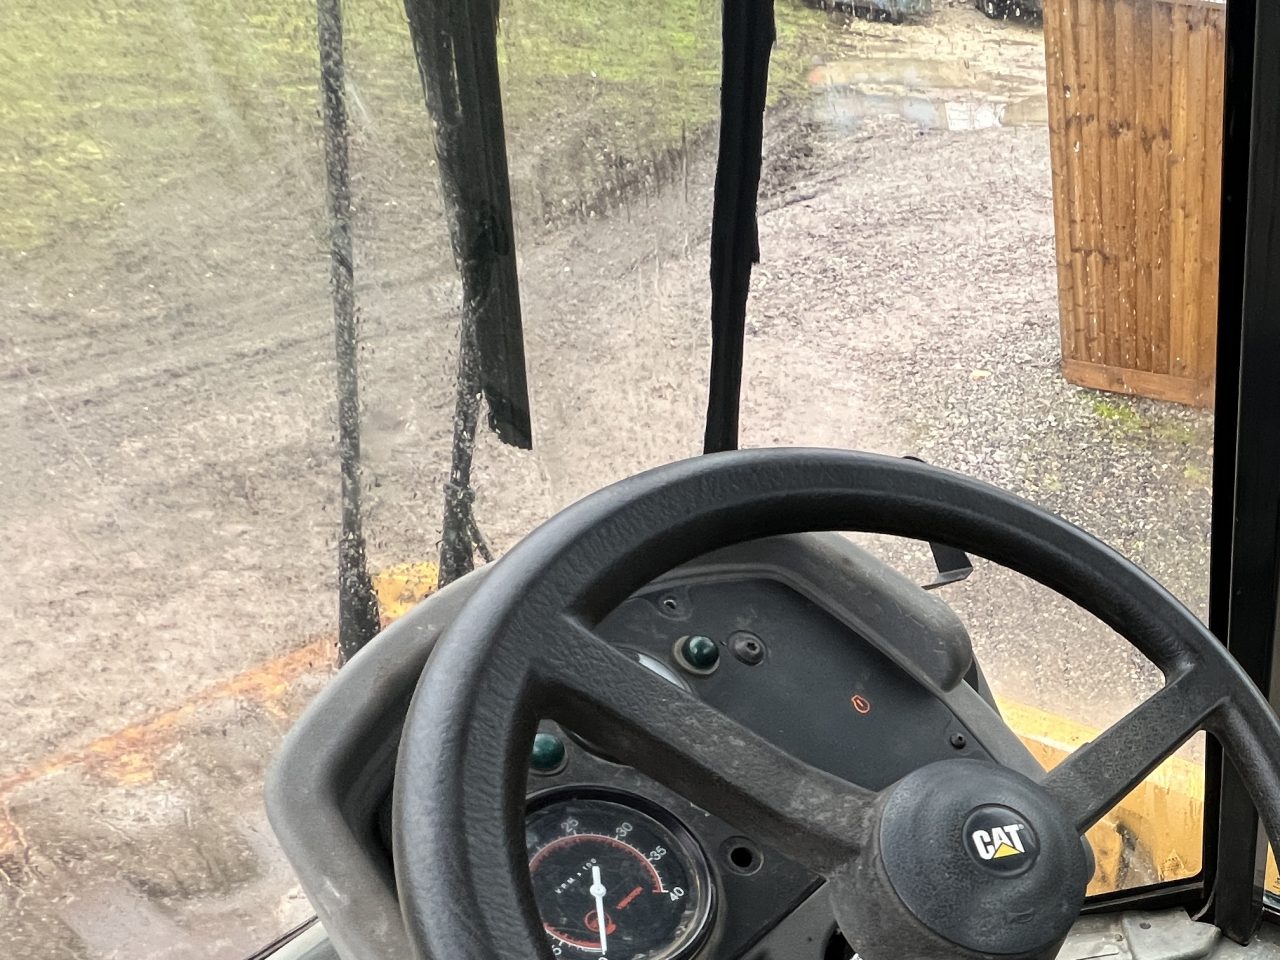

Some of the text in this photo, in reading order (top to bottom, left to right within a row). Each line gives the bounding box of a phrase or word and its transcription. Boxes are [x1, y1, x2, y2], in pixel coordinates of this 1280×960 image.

[560, 816, 579, 833] 25
[615, 821, 633, 838] 30
[972, 823, 1025, 860] CAT
[649, 845, 667, 861] 35
[669, 886, 685, 902] 40
